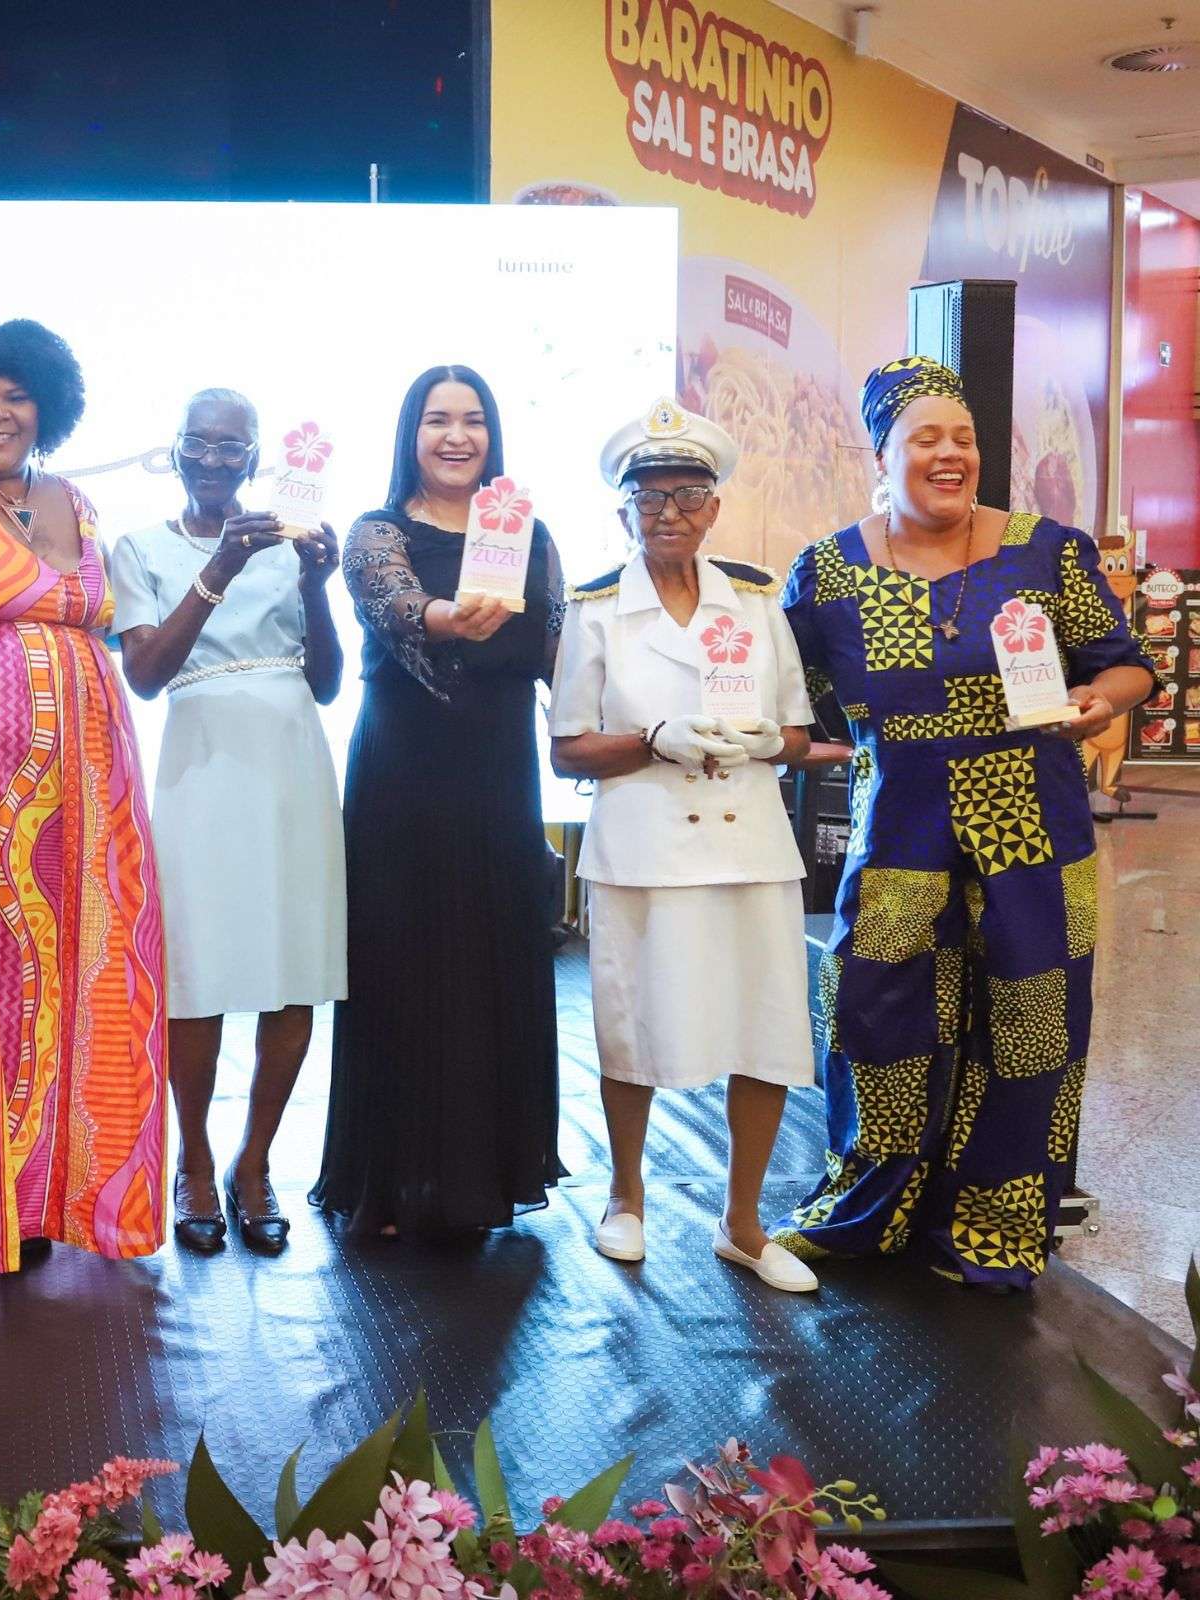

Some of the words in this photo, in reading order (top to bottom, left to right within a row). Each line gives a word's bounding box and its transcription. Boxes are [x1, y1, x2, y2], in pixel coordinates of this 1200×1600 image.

[611, 0, 830, 140] BARATINHO
[632, 80, 693, 158] SAL
[700, 105, 716, 166] E
[722, 114, 814, 199] BRASA
[472, 547, 523, 567] ZUZU
[709, 679, 755, 693] ZUZU
[1007, 666, 1057, 686] ZUZU
